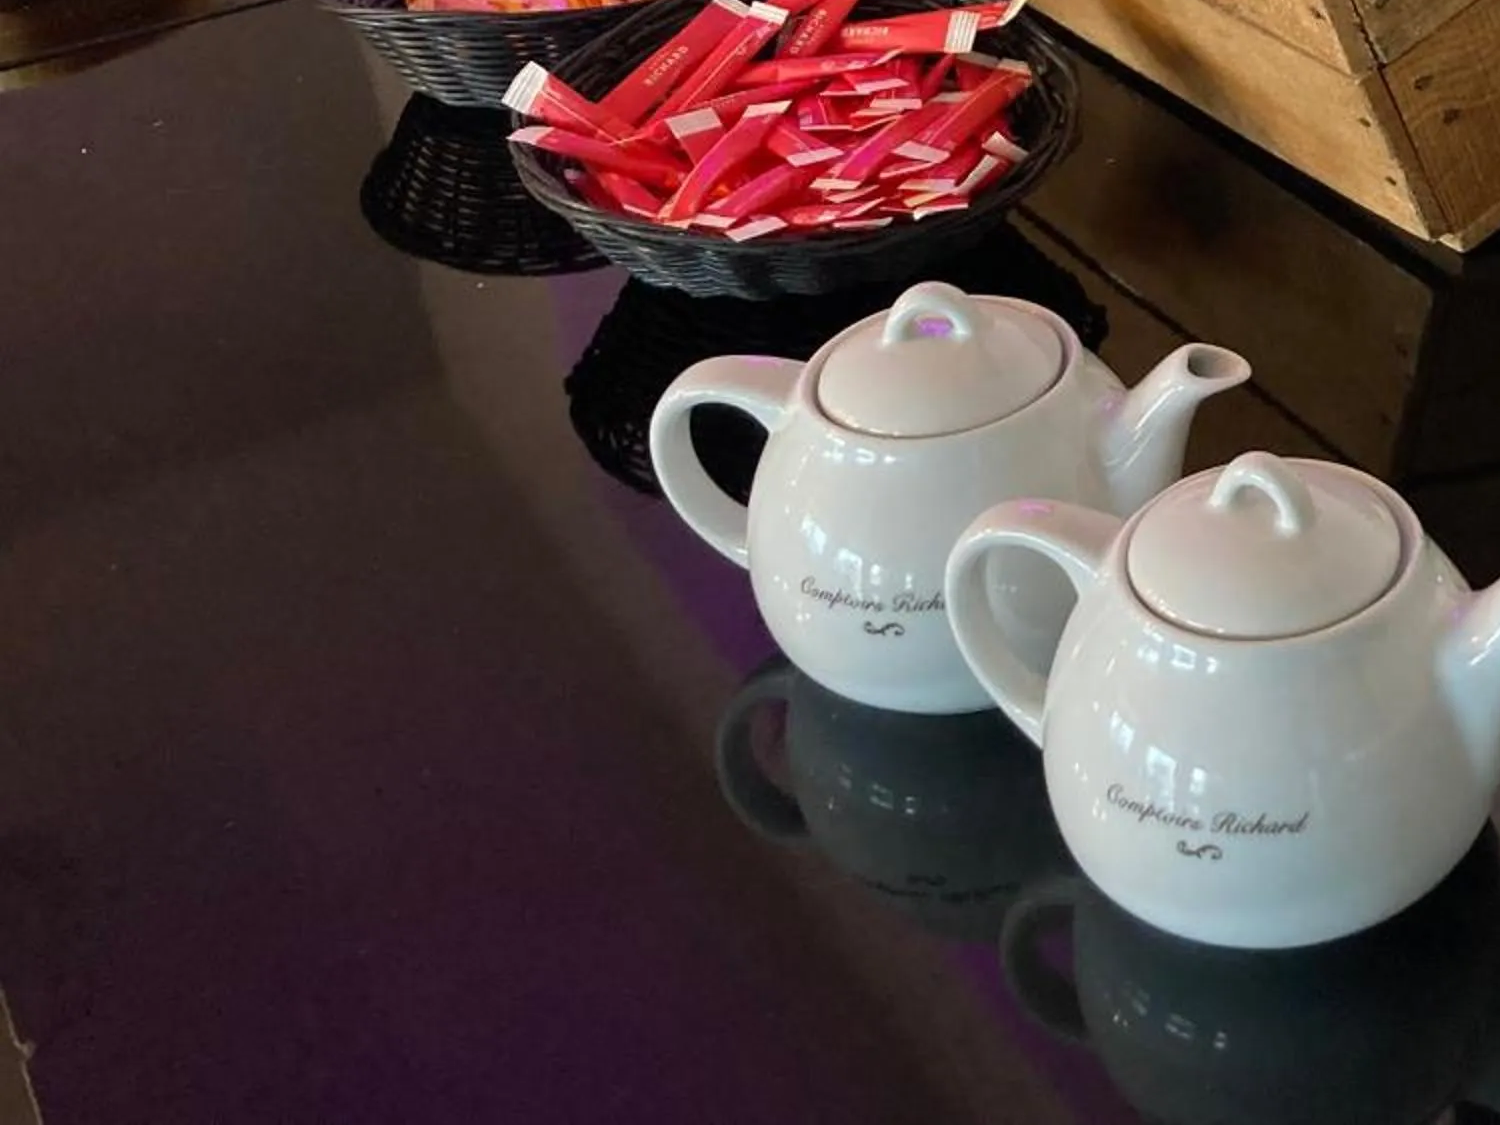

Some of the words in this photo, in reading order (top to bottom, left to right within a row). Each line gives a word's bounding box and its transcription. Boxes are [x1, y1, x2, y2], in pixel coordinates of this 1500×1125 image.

[643, 46, 689, 86] RICHARD
[1106, 783, 1202, 831] Comptoirs
[1210, 810, 1310, 835] Richard
